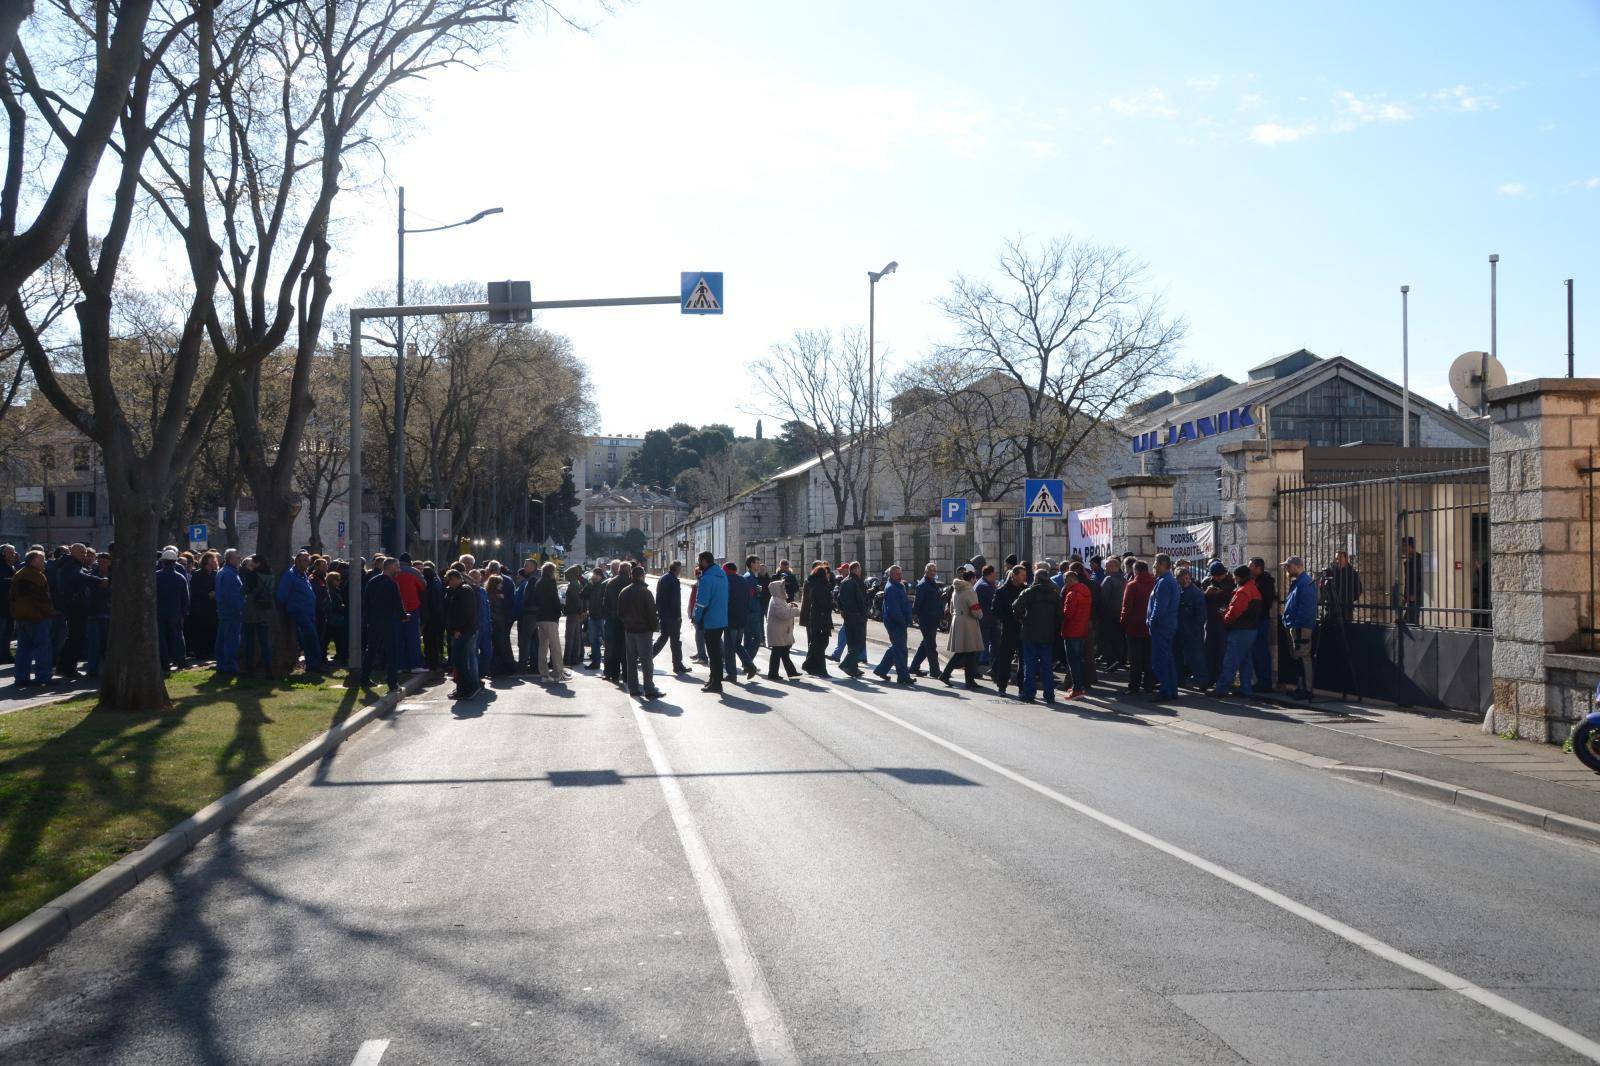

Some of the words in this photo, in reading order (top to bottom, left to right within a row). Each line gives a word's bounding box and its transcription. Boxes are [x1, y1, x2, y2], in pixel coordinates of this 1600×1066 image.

[1133, 404, 1254, 454] ULJANIK
[948, 502, 960, 518] P
[194, 528, 202, 538] P
[1080, 513, 1112, 538] UNIŠTI,
